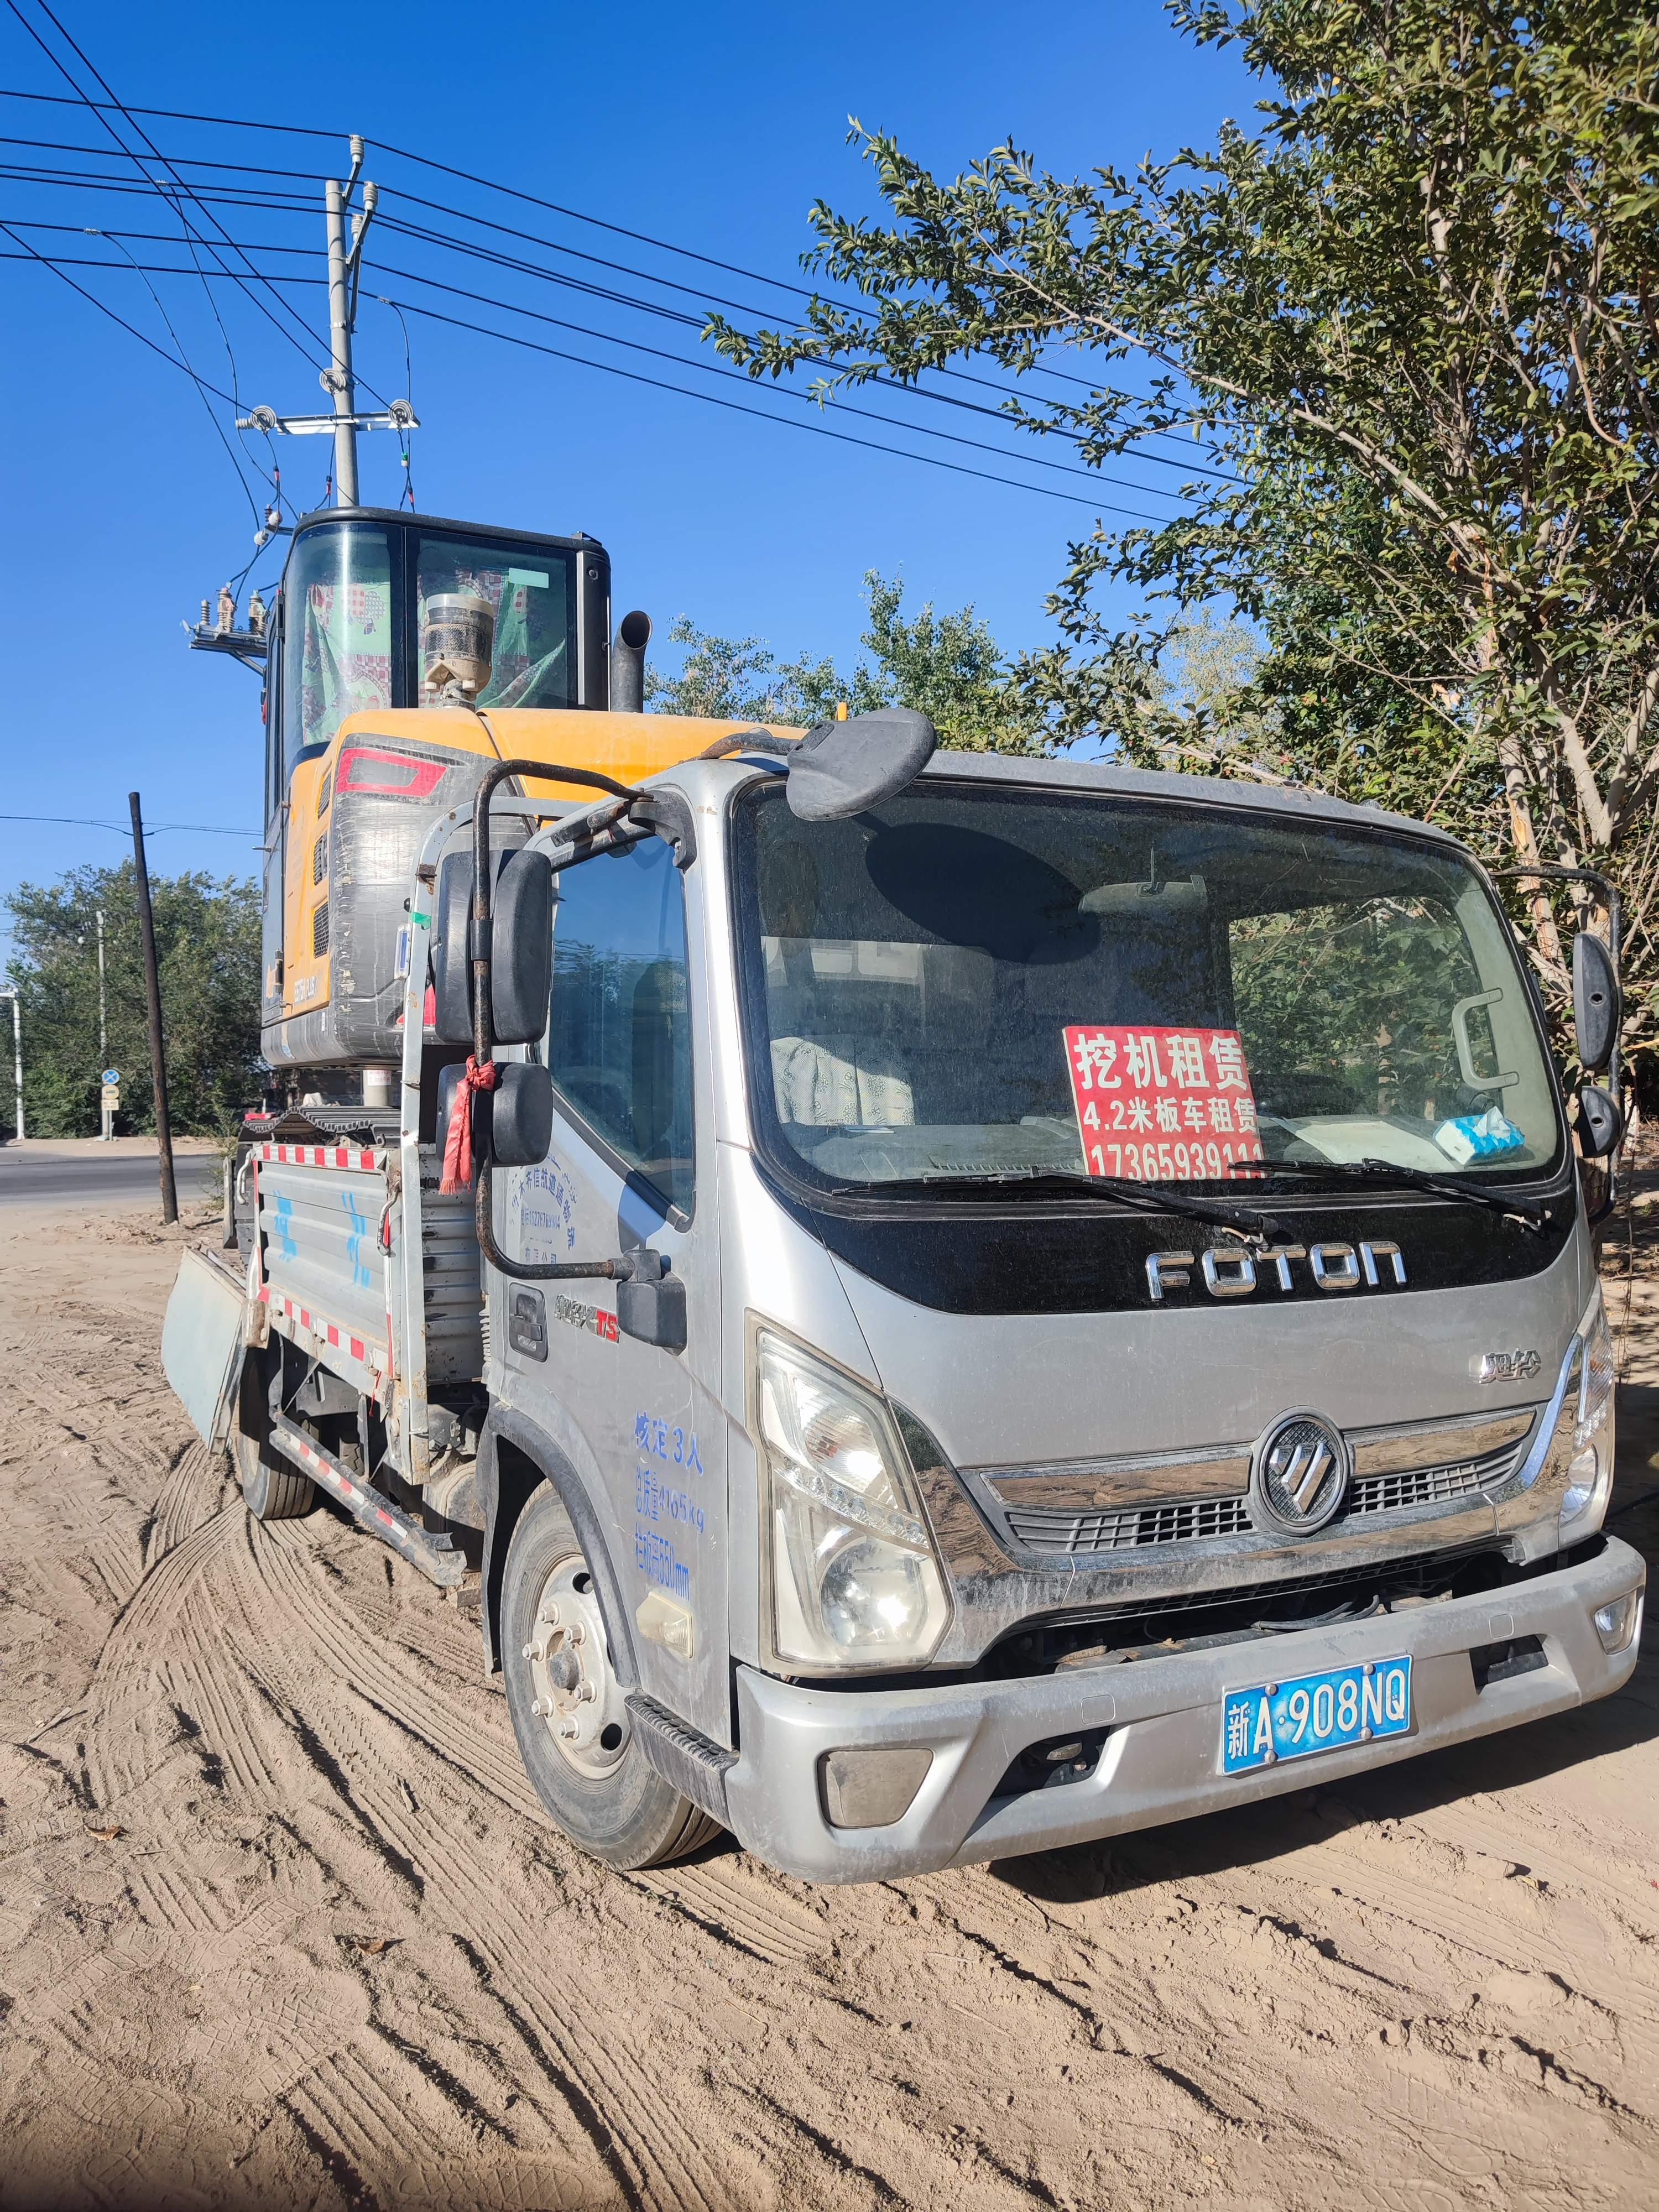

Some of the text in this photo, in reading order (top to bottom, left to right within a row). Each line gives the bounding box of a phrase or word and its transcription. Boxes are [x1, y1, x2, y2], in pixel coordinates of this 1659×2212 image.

[1074, 1033, 1247, 1091] 挖机租赁
[1083, 1096, 1257, 1134] 4.2米板车租赁
[1145, 1240, 1408, 1300] FOTON
